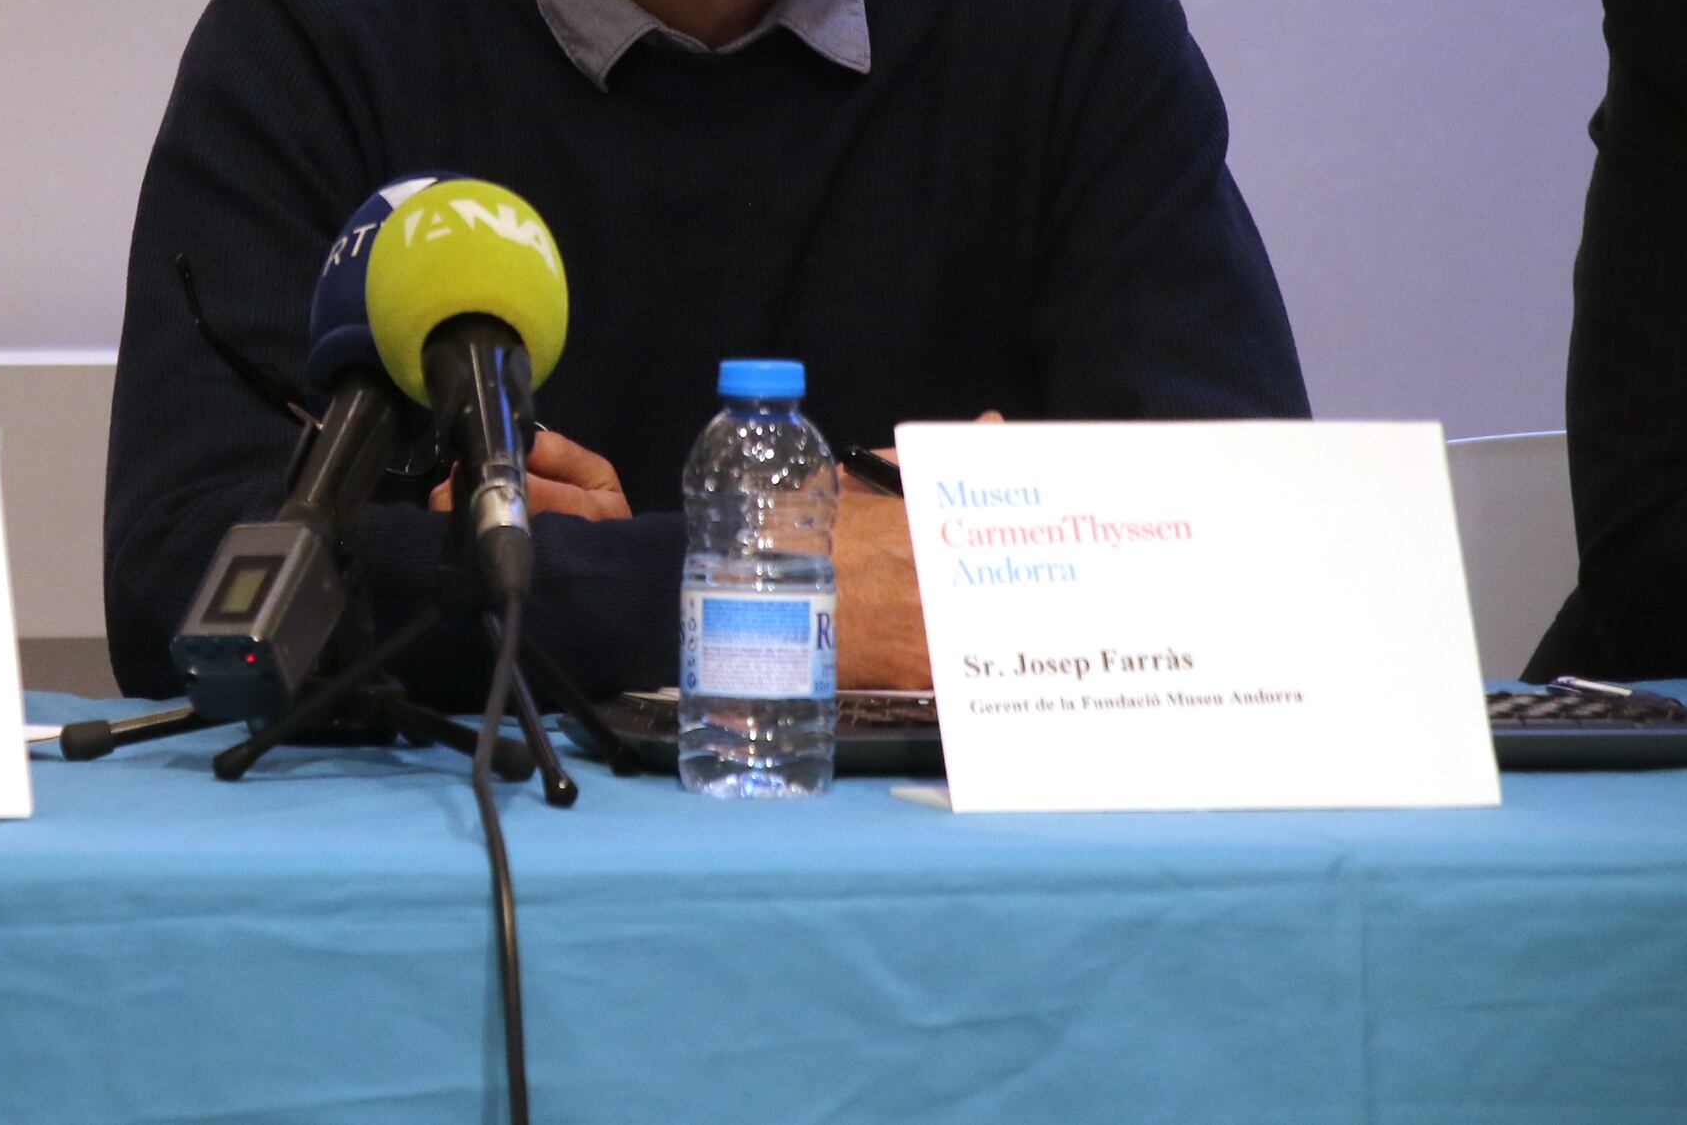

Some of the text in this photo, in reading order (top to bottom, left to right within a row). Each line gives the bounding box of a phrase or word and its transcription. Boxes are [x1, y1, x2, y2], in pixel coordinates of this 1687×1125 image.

[936, 480, 1041, 510] Museu
[940, 513, 1193, 549] CarmenThyssen
[952, 556, 1077, 587] Andorra
[963, 647, 1194, 681] Sr. Josep Farràs
[969, 688, 1304, 715] Gerent de la Fundació Museu Andorra
